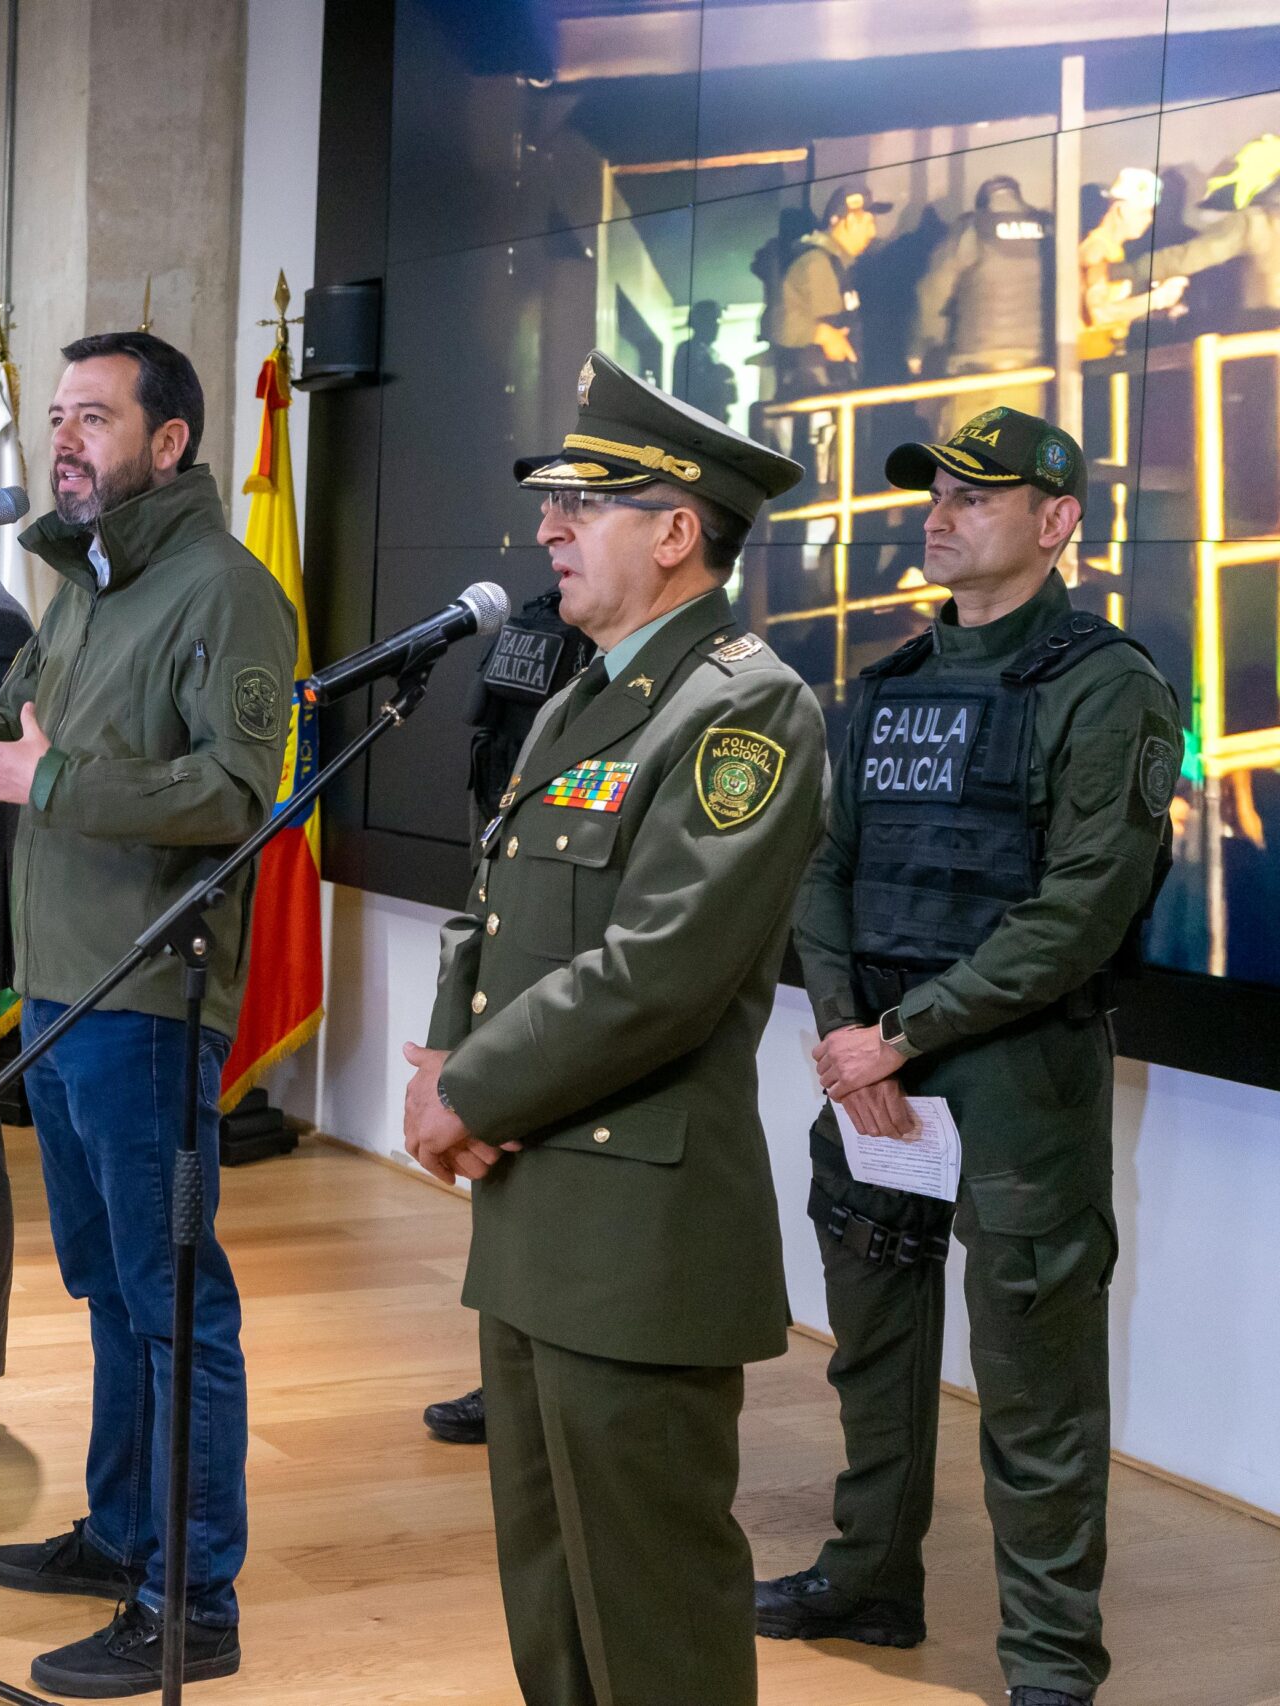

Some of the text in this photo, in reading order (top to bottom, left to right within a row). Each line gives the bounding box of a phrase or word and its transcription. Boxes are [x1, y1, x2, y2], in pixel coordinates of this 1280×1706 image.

[500, 630, 548, 661] GAULA
[872, 707, 967, 745] GAULA
[712, 747, 771, 774] NACIONAL
[721, 737, 770, 758] POLICÍA
[863, 743, 953, 792] POLICÍA
